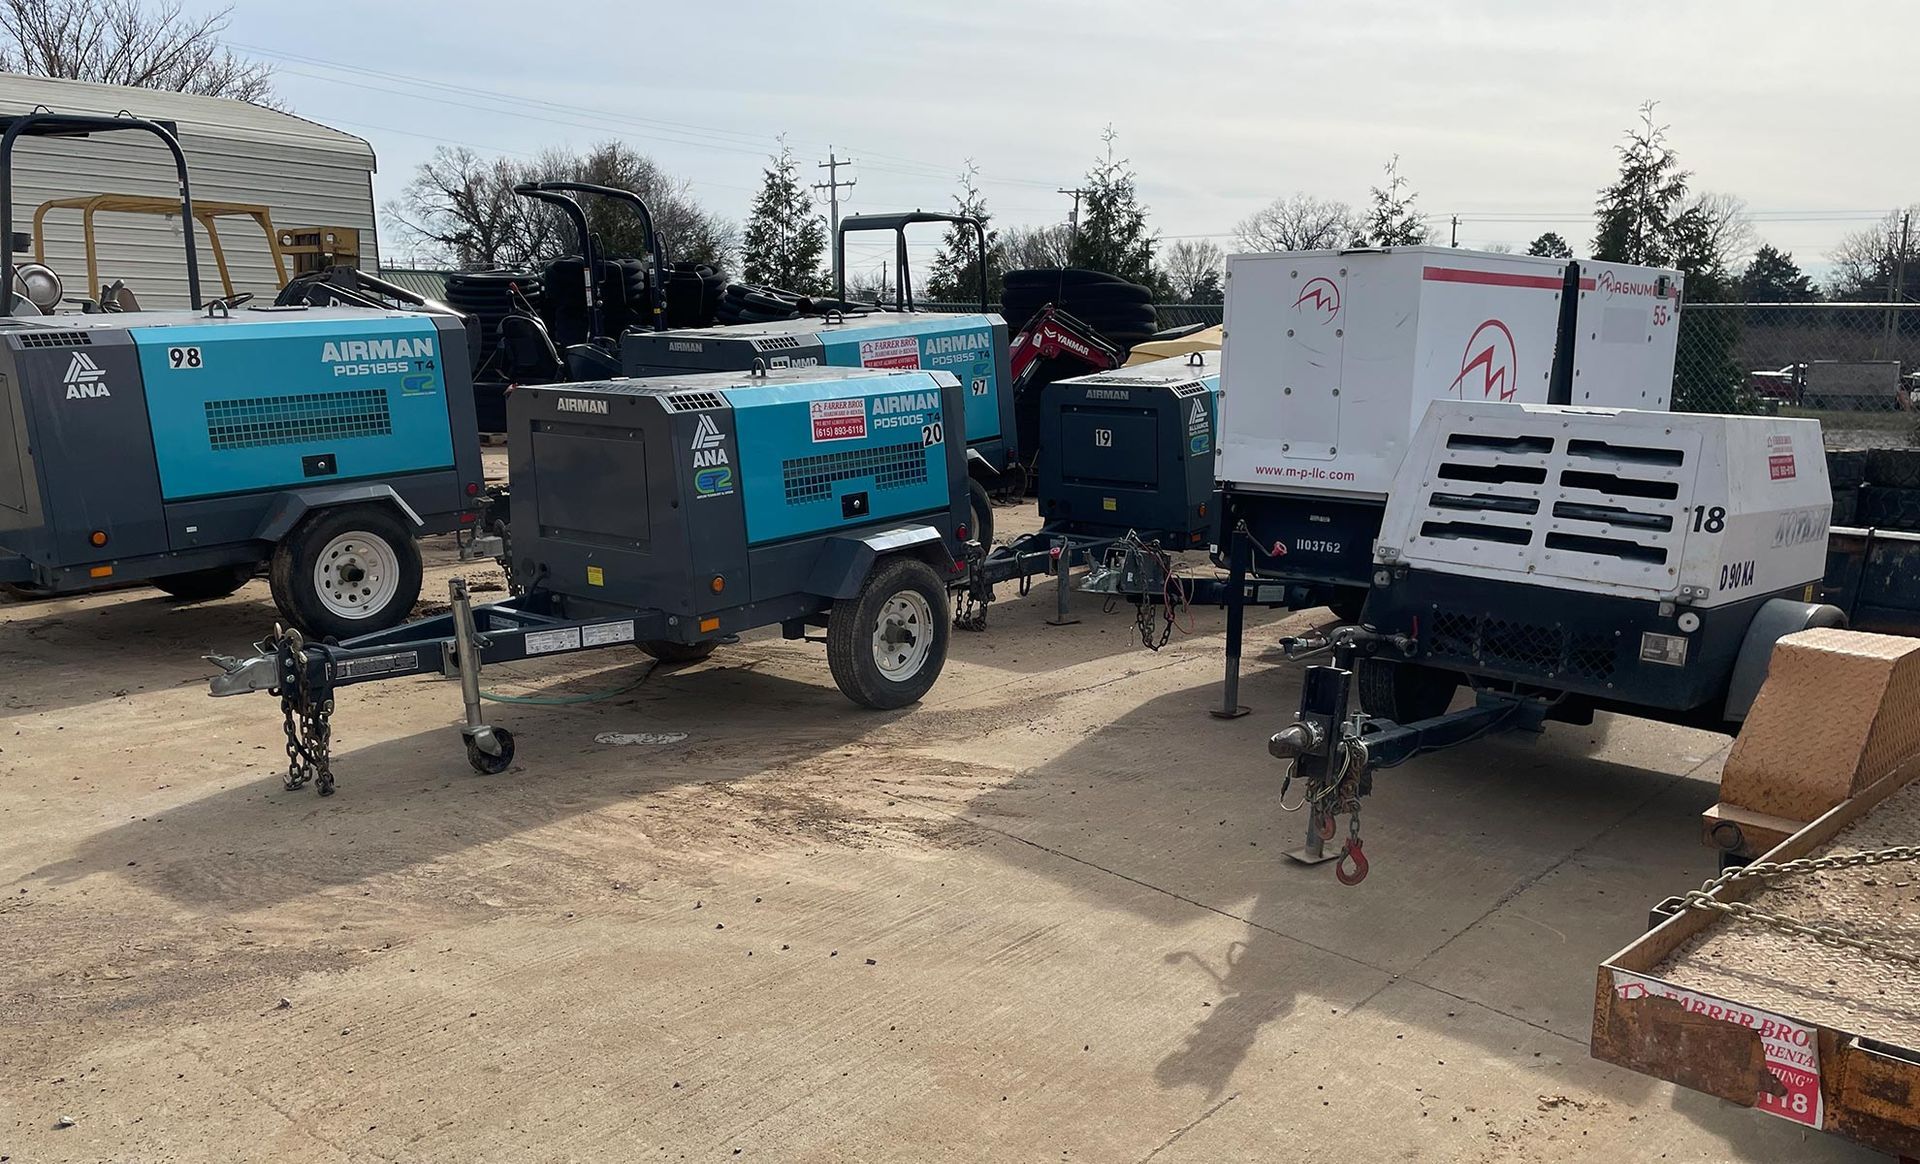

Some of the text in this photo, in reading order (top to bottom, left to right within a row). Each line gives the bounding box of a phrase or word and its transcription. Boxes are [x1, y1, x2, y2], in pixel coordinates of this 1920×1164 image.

[1653, 305, 1666, 326] 55
[321, 338, 434, 363] AIRMAN
[668, 341, 703, 353] AIRMAN
[874, 339, 900, 351] FARRER
[926, 332, 990, 355] AIRMAN
[1057, 334, 1090, 356] YANMAR
[170, 348, 201, 368] 98
[791, 357, 818, 369] MMD
[932, 350, 990, 366] PDS185S T4
[334, 360, 436, 377] PDS185S T4
[66, 382, 111, 400] ANA
[972, 380, 985, 396] 97
[1085, 389, 1129, 400] AIRMAN
[557, 397, 609, 415] AIRMAN
[823, 400, 864, 411] FARRER BROS
[872, 392, 939, 415] AIRMAN
[874, 412, 940, 429] PDS100S T4
[815, 426, 834, 438] (615)
[922, 423, 942, 446] 20
[1096, 430, 1111, 446] 19
[693, 448, 729, 468] ANA
[1255, 466, 1355, 481] www.m-p-llc.com
[1693, 505, 1726, 533] 18
[1296, 538, 1341, 553] 1103762
[1720, 560, 1755, 591] D 90 KA
